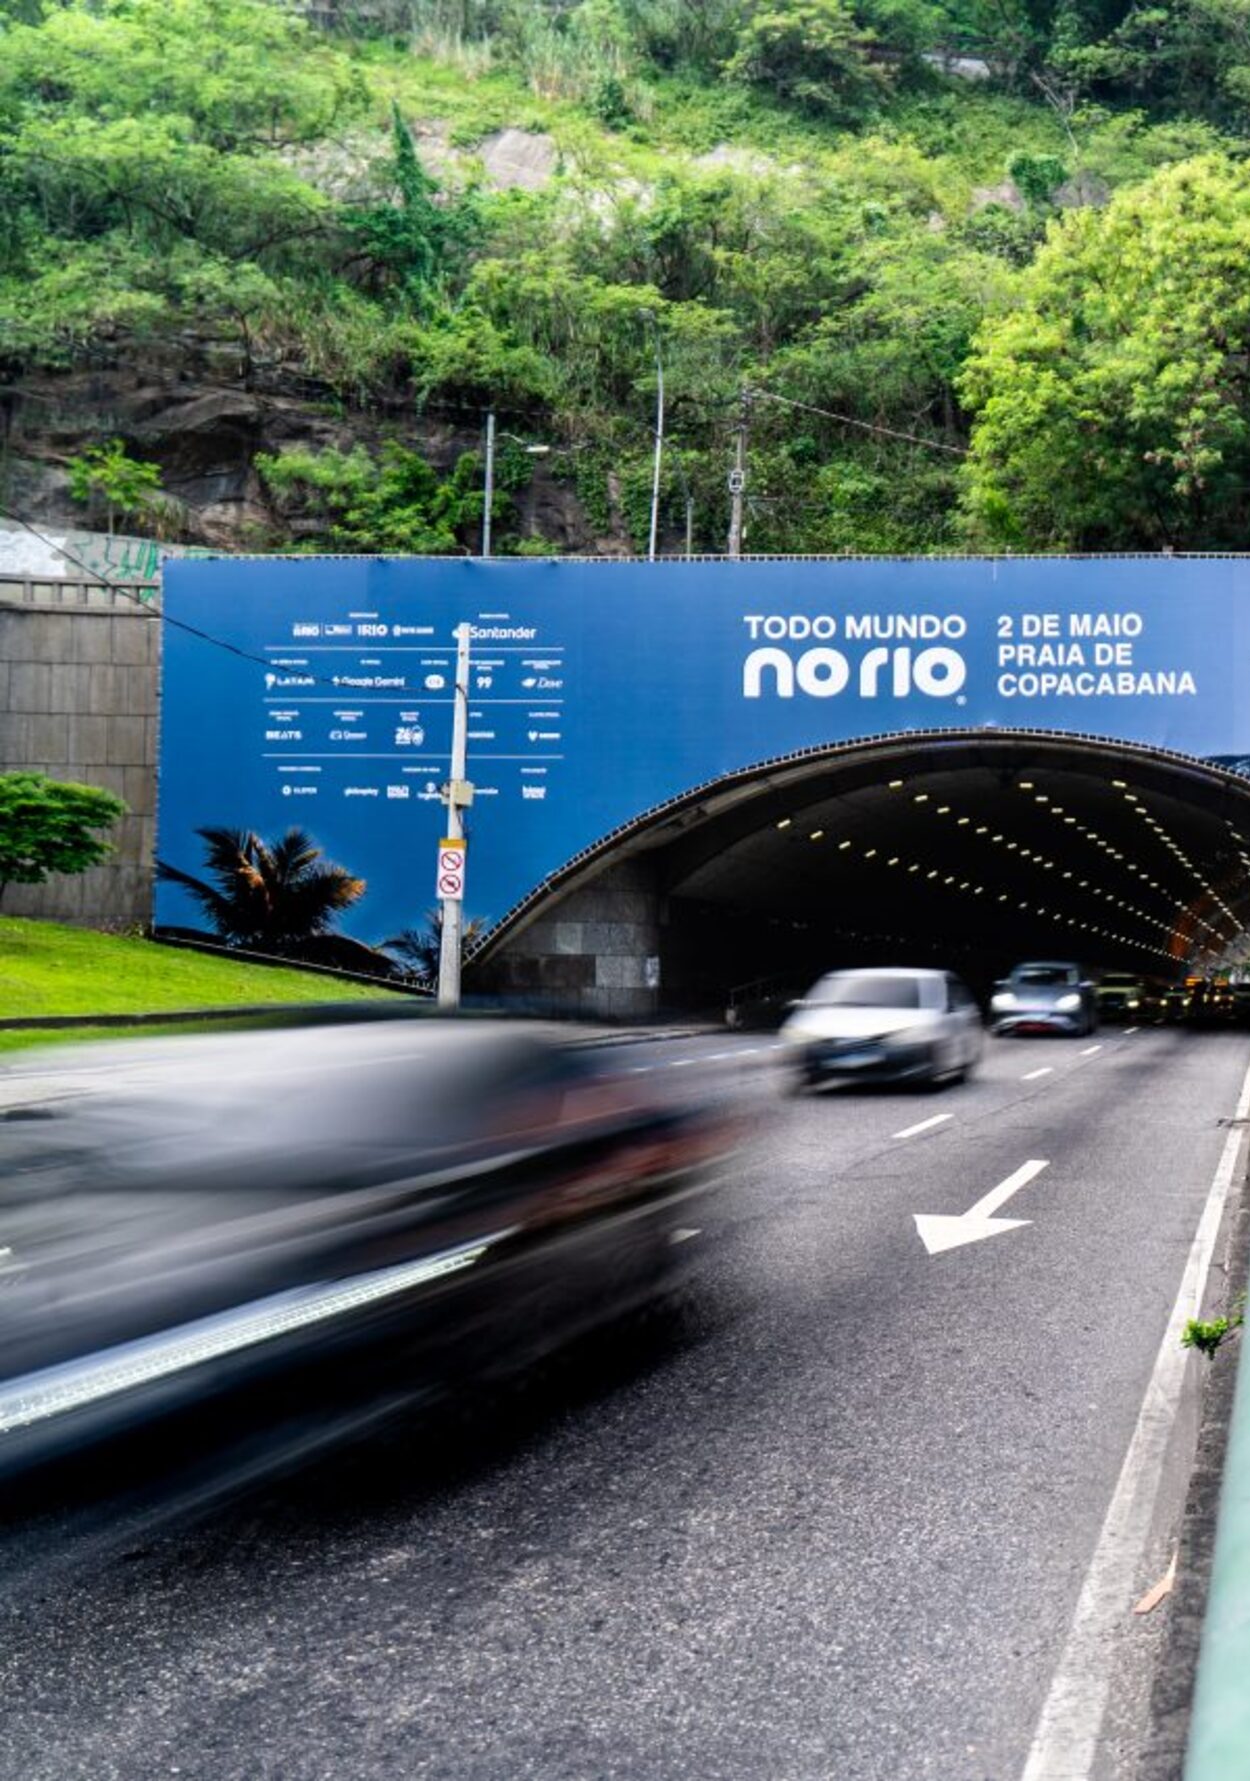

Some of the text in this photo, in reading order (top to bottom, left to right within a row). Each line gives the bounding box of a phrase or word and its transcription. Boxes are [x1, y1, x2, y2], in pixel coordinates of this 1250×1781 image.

[470, 626, 536, 640] Santander
[744, 614, 967, 639] TODO MUNDO
[998, 613, 1142, 637] 2 DE MAIO
[998, 643, 1133, 667] PRAIA DE
[477, 676, 493, 689] 99
[997, 672, 1197, 697] COPACABANA
[265, 730, 302, 740] BEATS
